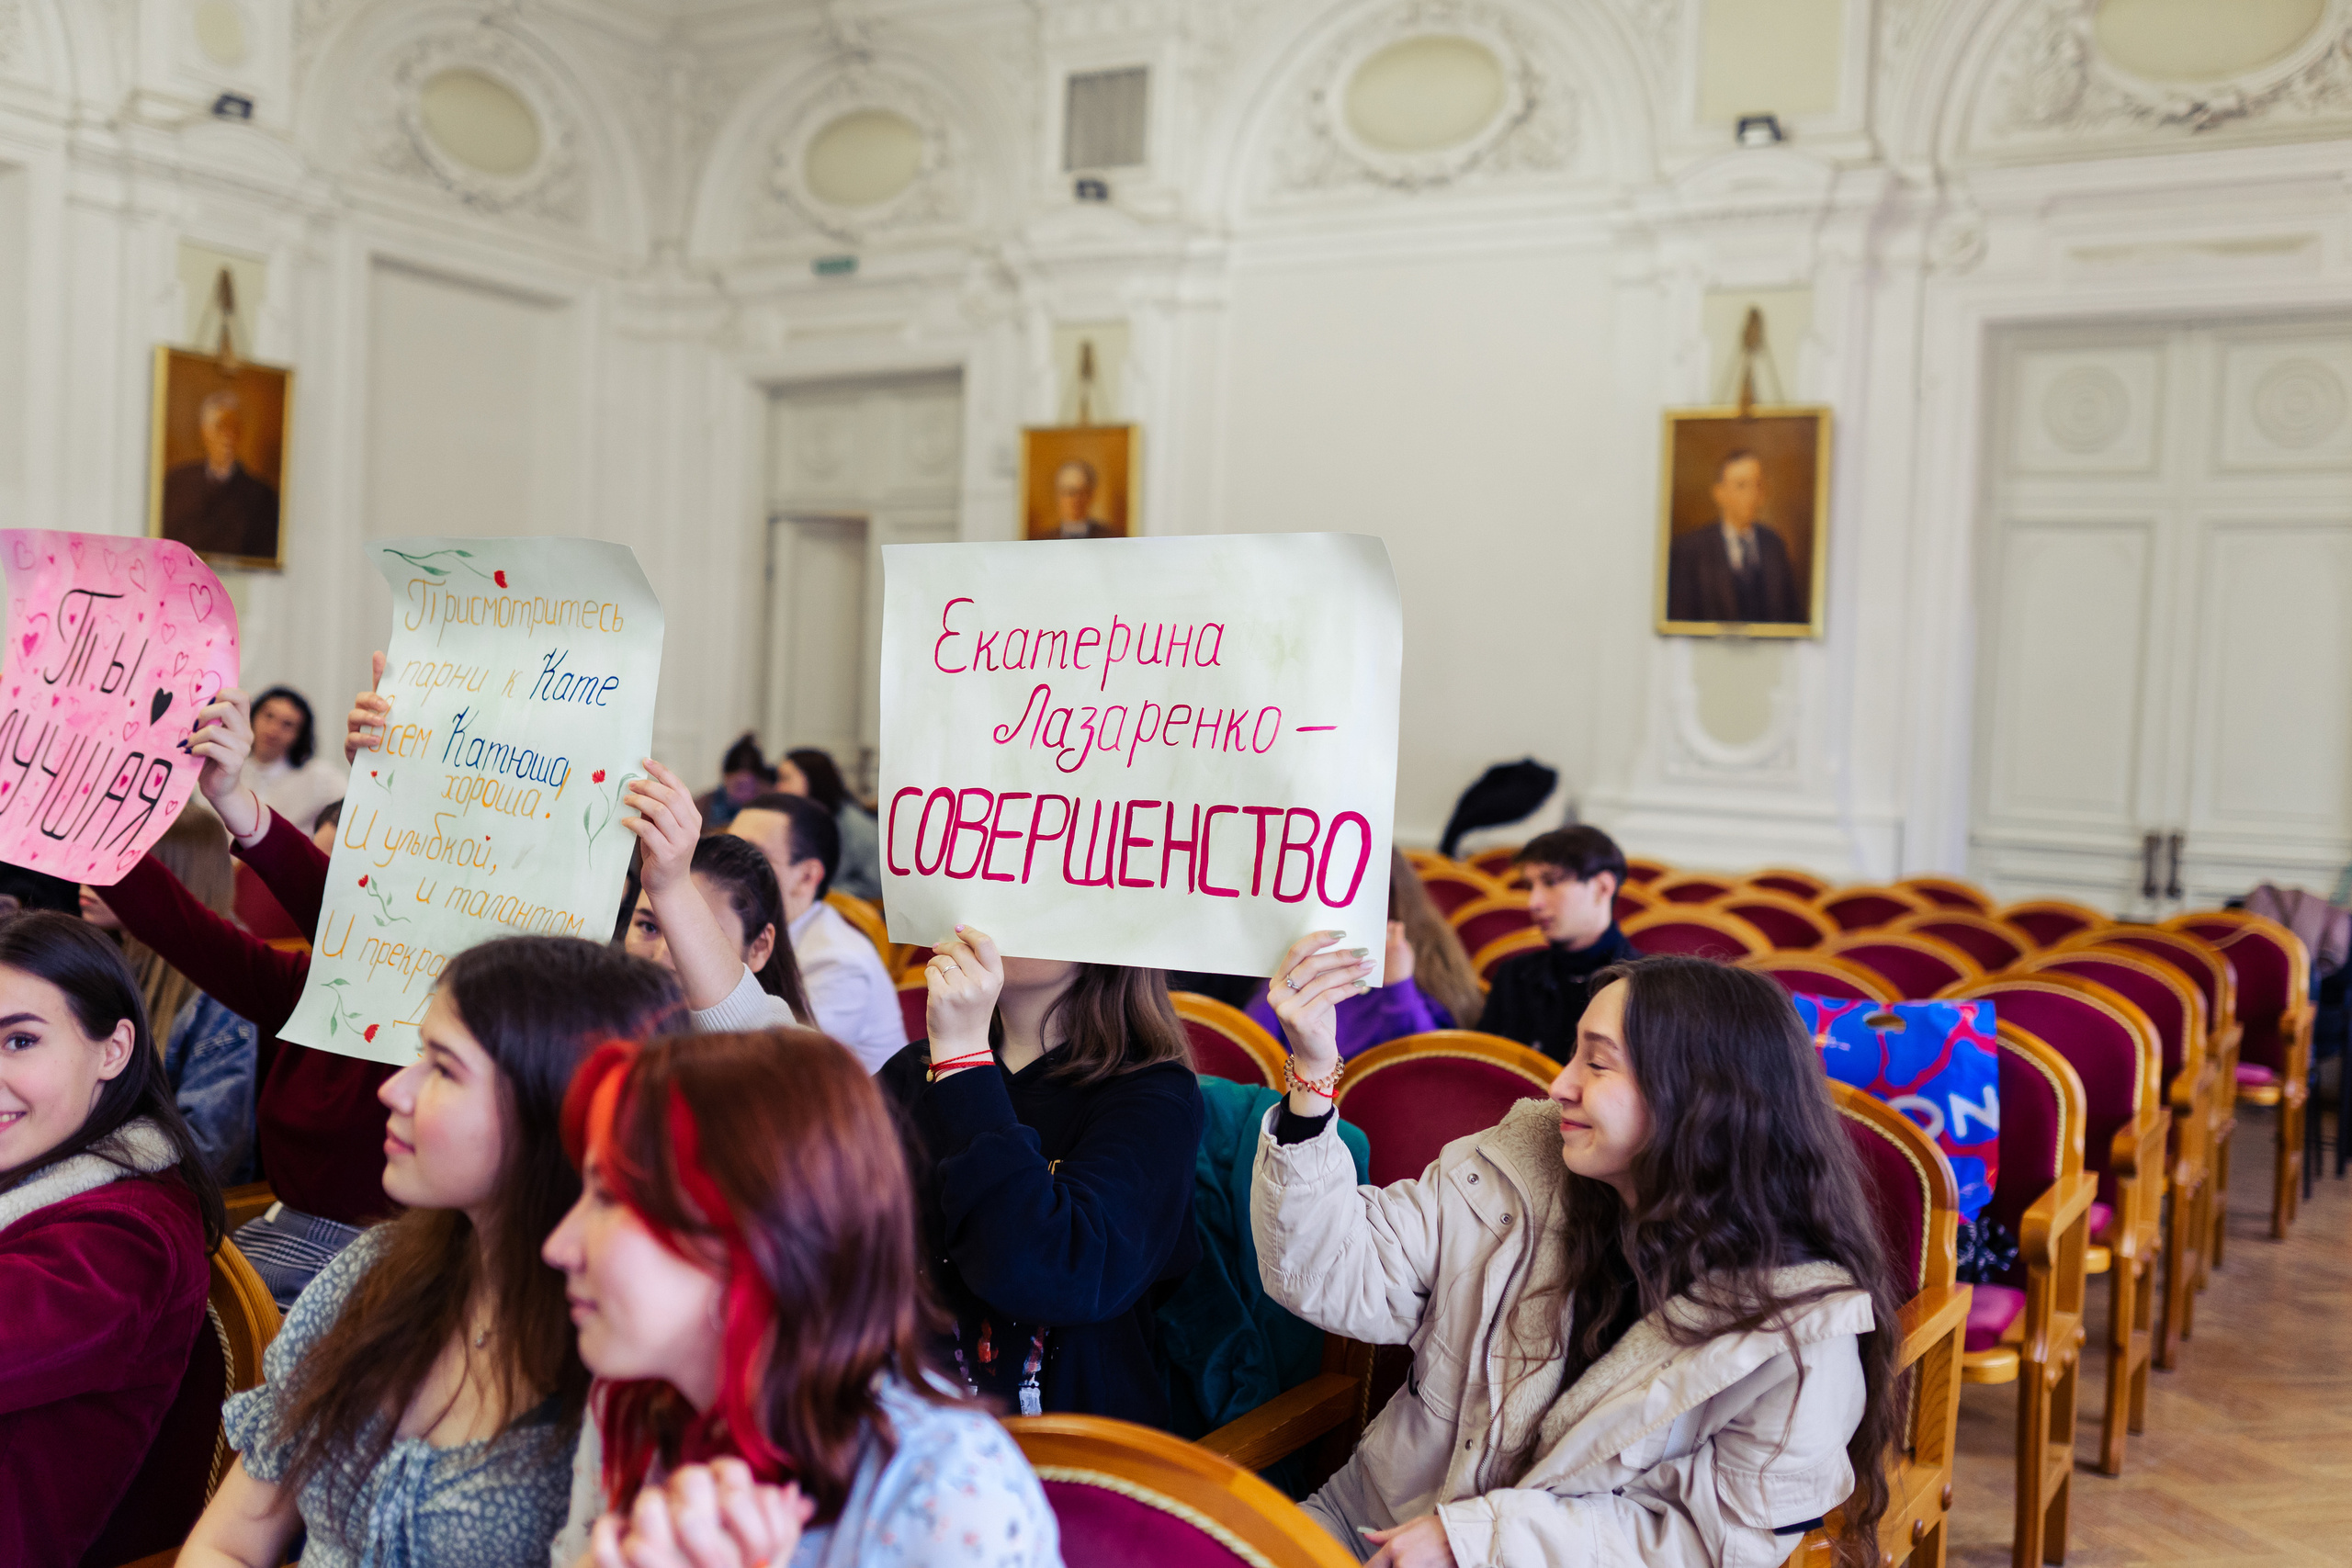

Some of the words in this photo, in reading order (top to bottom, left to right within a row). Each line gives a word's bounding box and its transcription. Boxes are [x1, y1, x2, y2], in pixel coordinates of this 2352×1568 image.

[44, 589, 149, 696] Ты
[405, 579, 624, 647] Присмотритесь
[934, 597, 1226, 691] Екатерина
[398, 660, 489, 706] парни
[502, 670, 523, 698] к
[529, 648, 619, 705] Кате
[442, 705, 569, 788] Катюша
[993, 683, 1283, 773] Лазаренко
[345, 804, 378, 851] И
[887, 786, 1372, 908] СОВЕРШЕНСТВО
[416, 876, 436, 904] и
[445, 886, 584, 937] талантом
[322, 910, 355, 960] И
[358, 937, 446, 993] прекра
